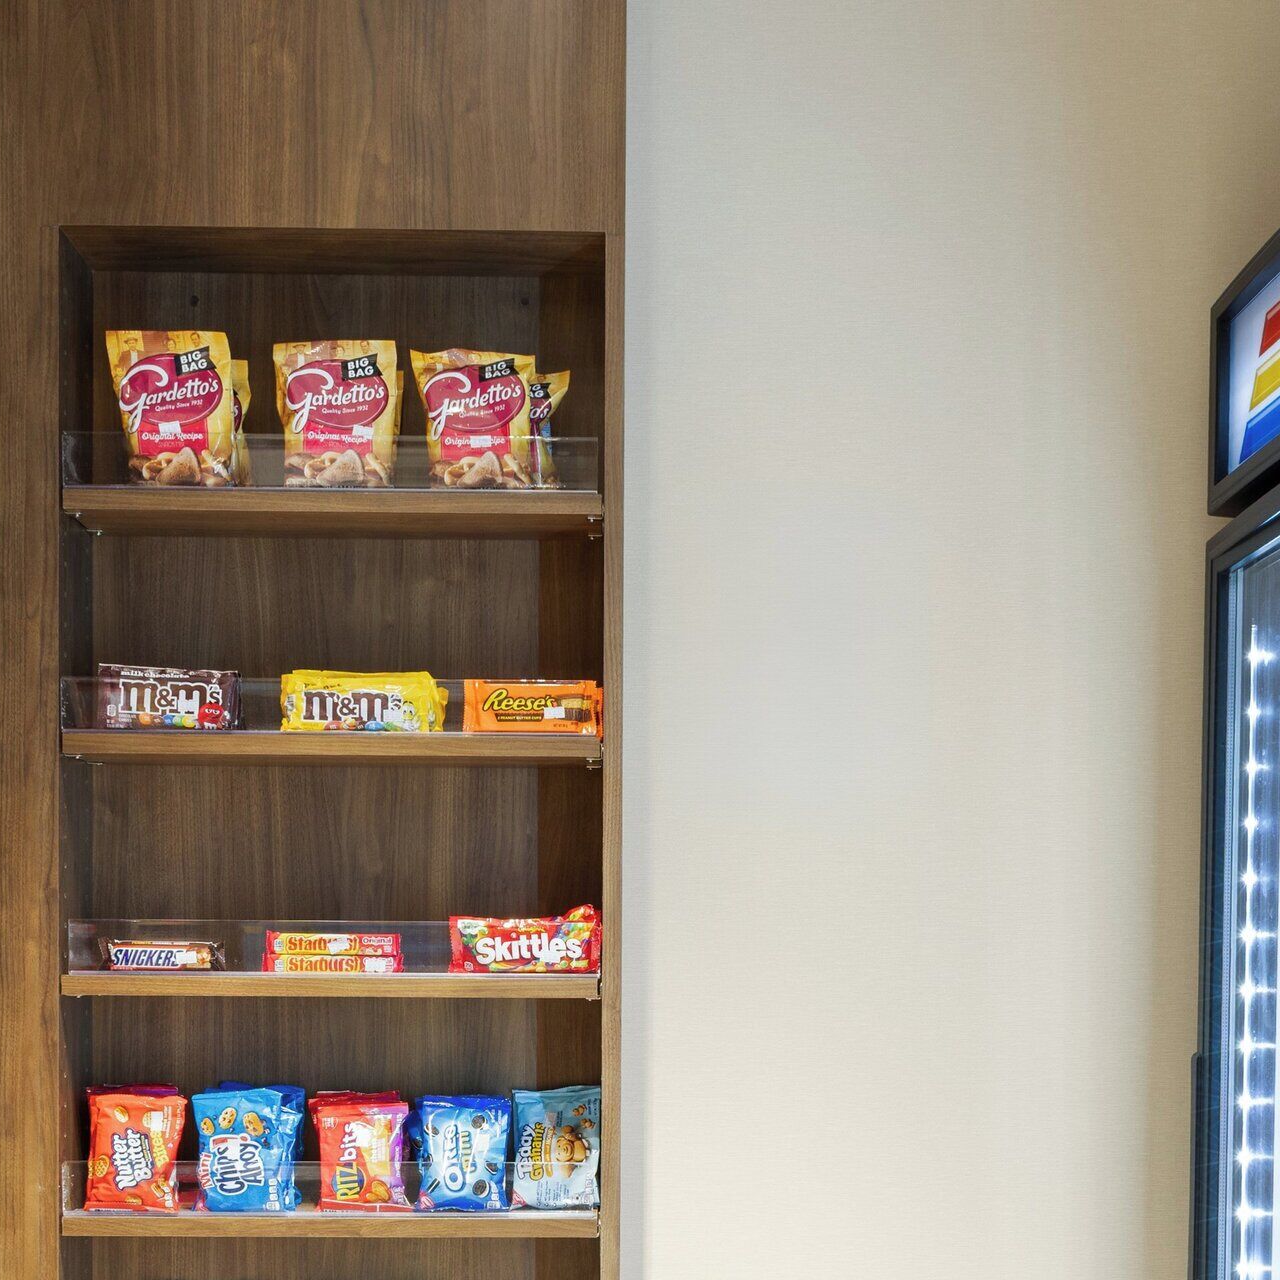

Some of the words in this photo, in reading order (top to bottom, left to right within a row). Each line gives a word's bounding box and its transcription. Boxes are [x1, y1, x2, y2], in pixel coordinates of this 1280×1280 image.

[180, 351, 202, 364] BIG
[181, 359, 208, 373] BAG
[347, 357, 370, 370] BIG
[348, 366, 374, 378] BAG
[485, 361, 507, 372] BIG
[485, 368, 511, 379] BAG
[119, 364, 219, 434] Gardetto's
[286, 368, 385, 434] Gardetto's
[423, 371, 522, 441] Gardetto's
[307, 431, 340, 443] Original
[482, 688, 555, 712] Reese's
[112, 948, 180, 967] SNICKERS
[475, 931, 582, 965] Skittles
[113, 1134, 138, 1190] Nutter
[128, 1130, 152, 1182] Butter
[216, 1144, 246, 1195] Chips
[199, 1152, 214, 1190] Mini
[336, 1162, 360, 1201] RITZ
